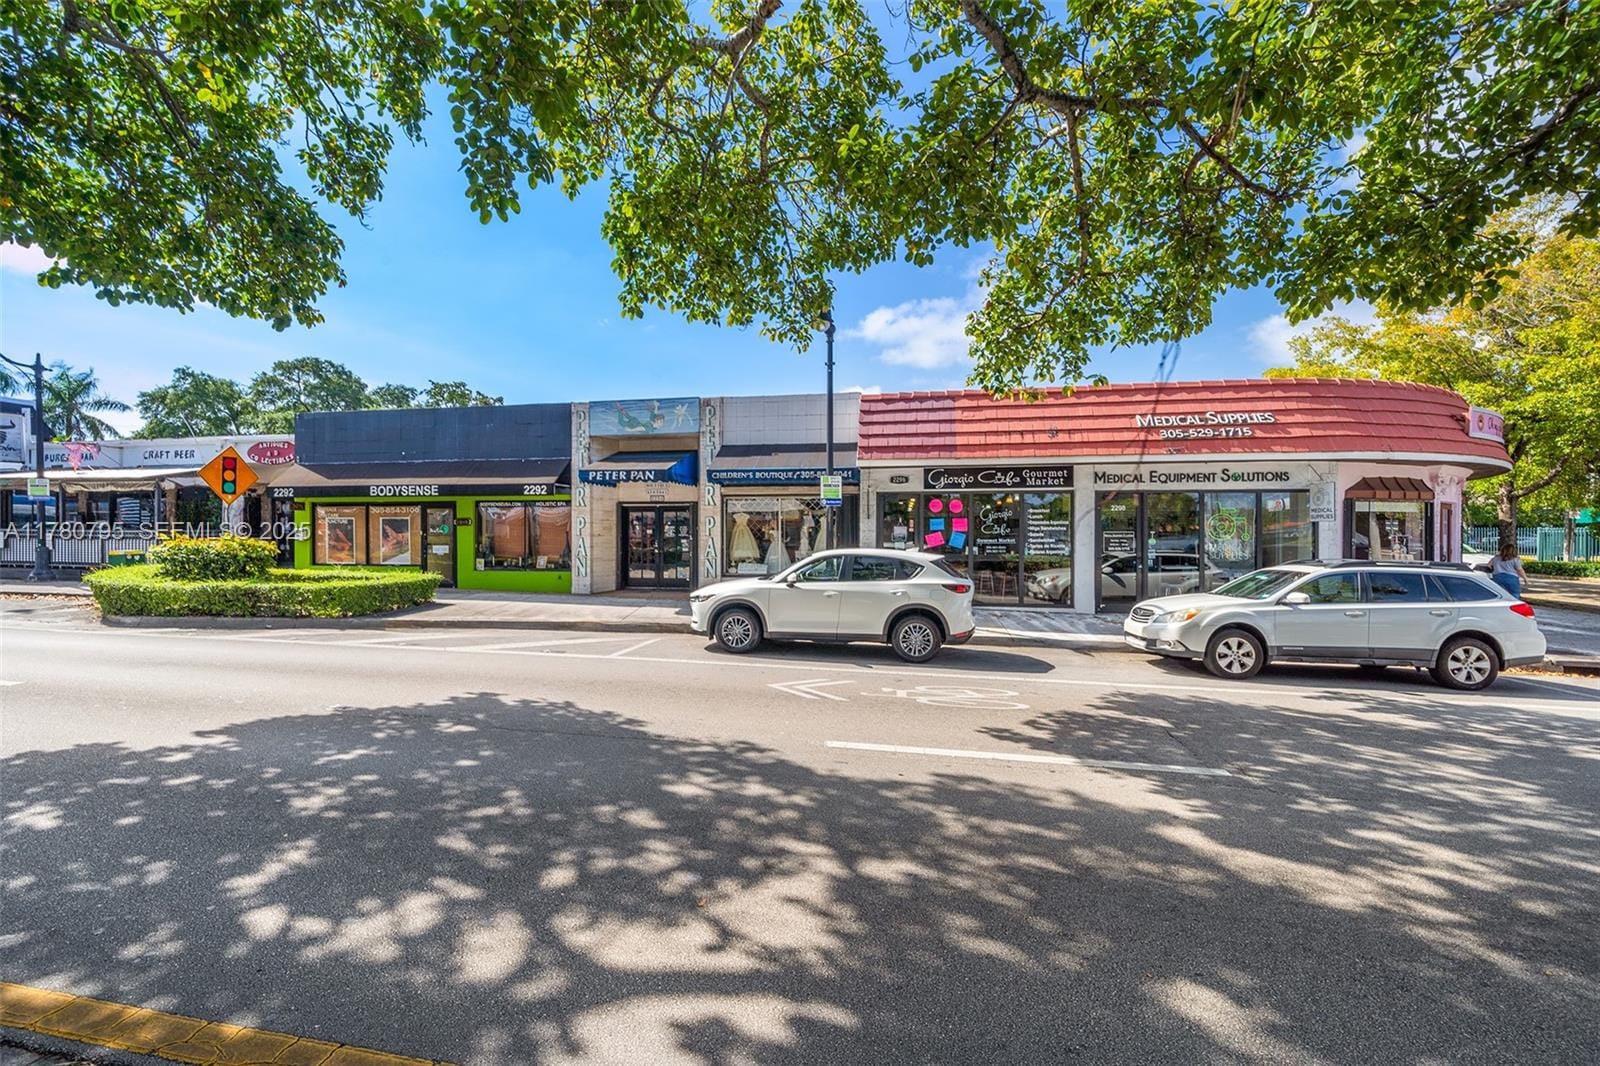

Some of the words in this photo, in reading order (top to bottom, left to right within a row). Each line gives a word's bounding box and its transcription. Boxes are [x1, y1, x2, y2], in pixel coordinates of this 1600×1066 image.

[1135, 413, 1205, 428] MEDICAL
[1207, 411, 1275, 425] SUPPLIES
[1160, 427, 1252, 439] 305-529-1715
[143, 450, 169, 460] CRAFT
[174, 449, 195, 459] BEER
[588, 471, 627, 480] PETER
[630, 470, 655, 480] PAN
[711, 471, 754, 479] CHILDREN'S
[755, 471, 793, 480] BOUTIQUE
[927, 468, 975, 489] Giorgio
[1022, 469, 1068, 478] Gourmet
[1026, 477, 1064, 486] Market
[273, 488, 295, 498] 2292
[369, 485, 439, 496] BODYSENSE
[523, 485, 548, 495] 2292
